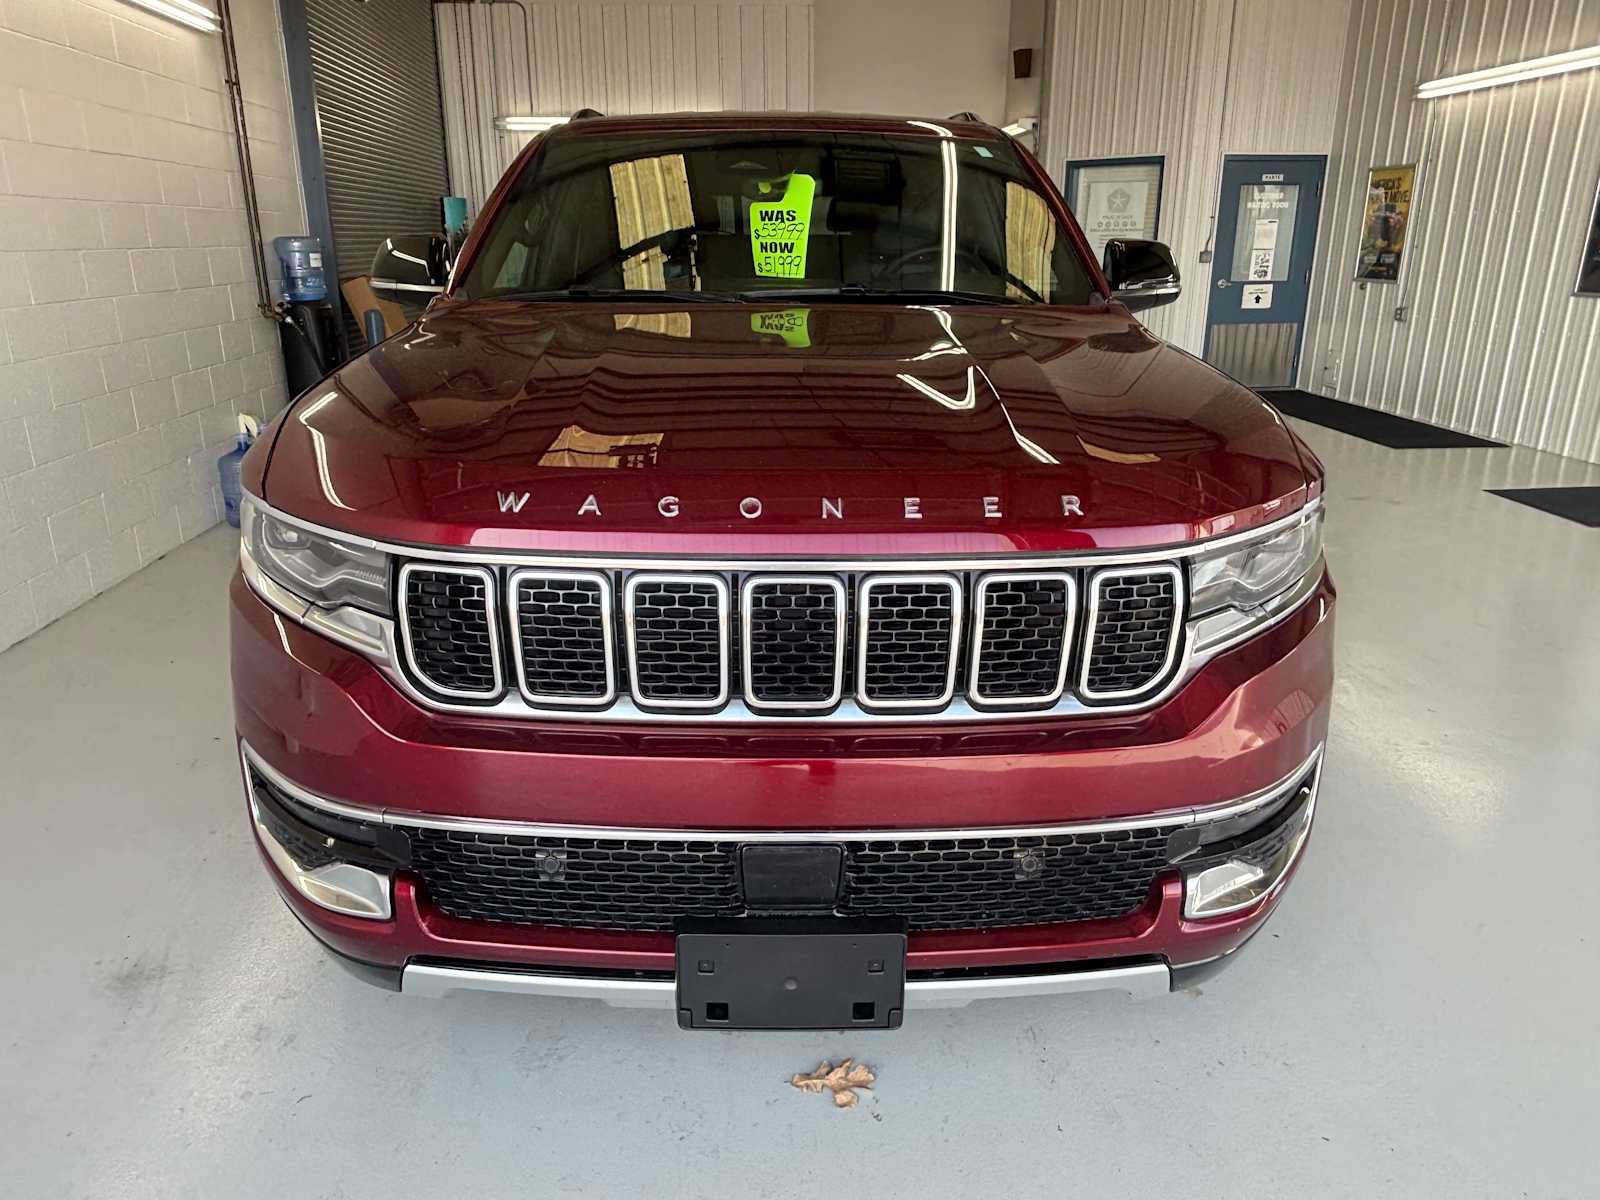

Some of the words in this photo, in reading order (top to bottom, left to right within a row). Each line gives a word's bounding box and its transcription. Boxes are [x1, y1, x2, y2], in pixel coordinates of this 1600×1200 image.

[759, 210, 797, 222] WAS
[760, 242, 795, 253] NOW
[496, 490, 1084, 518] WAGONEER
